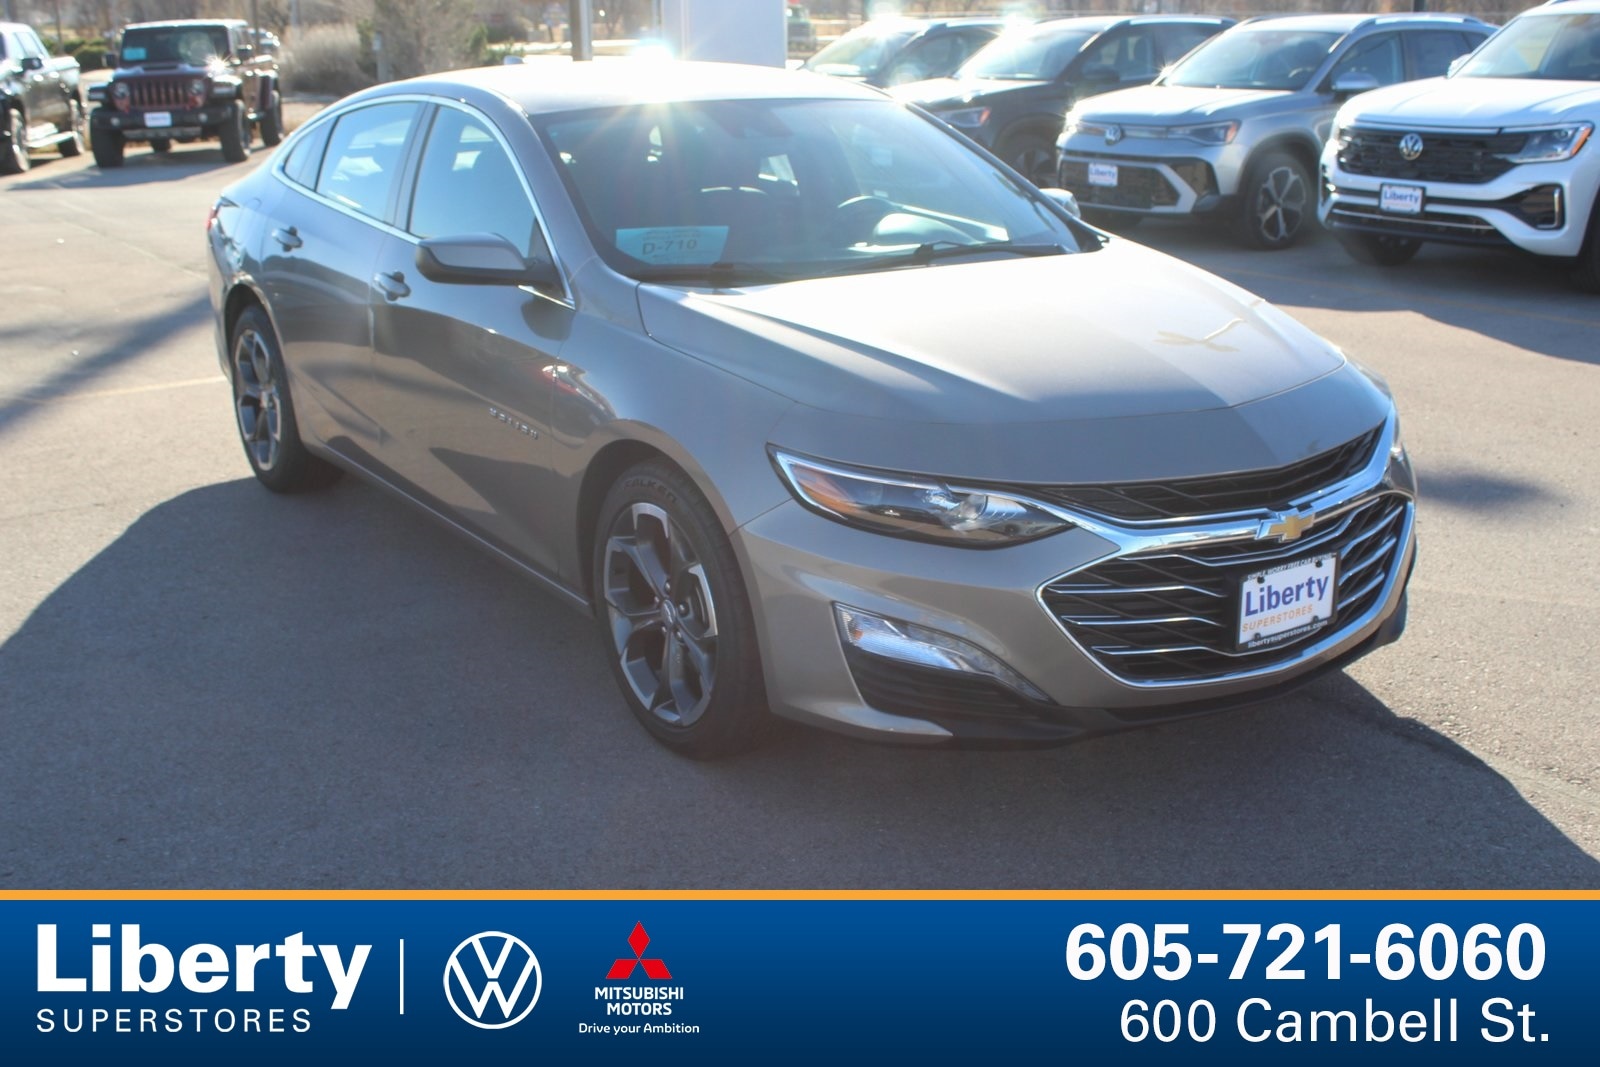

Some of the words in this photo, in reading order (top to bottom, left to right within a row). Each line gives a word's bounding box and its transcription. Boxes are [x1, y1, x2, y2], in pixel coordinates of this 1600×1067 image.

[1383, 190, 1420, 204] Liberty
[642, 239, 697, 256] D-710
[1245, 575, 1329, 617] Liberty
[1242, 604, 1313, 633] SUPERSTORES
